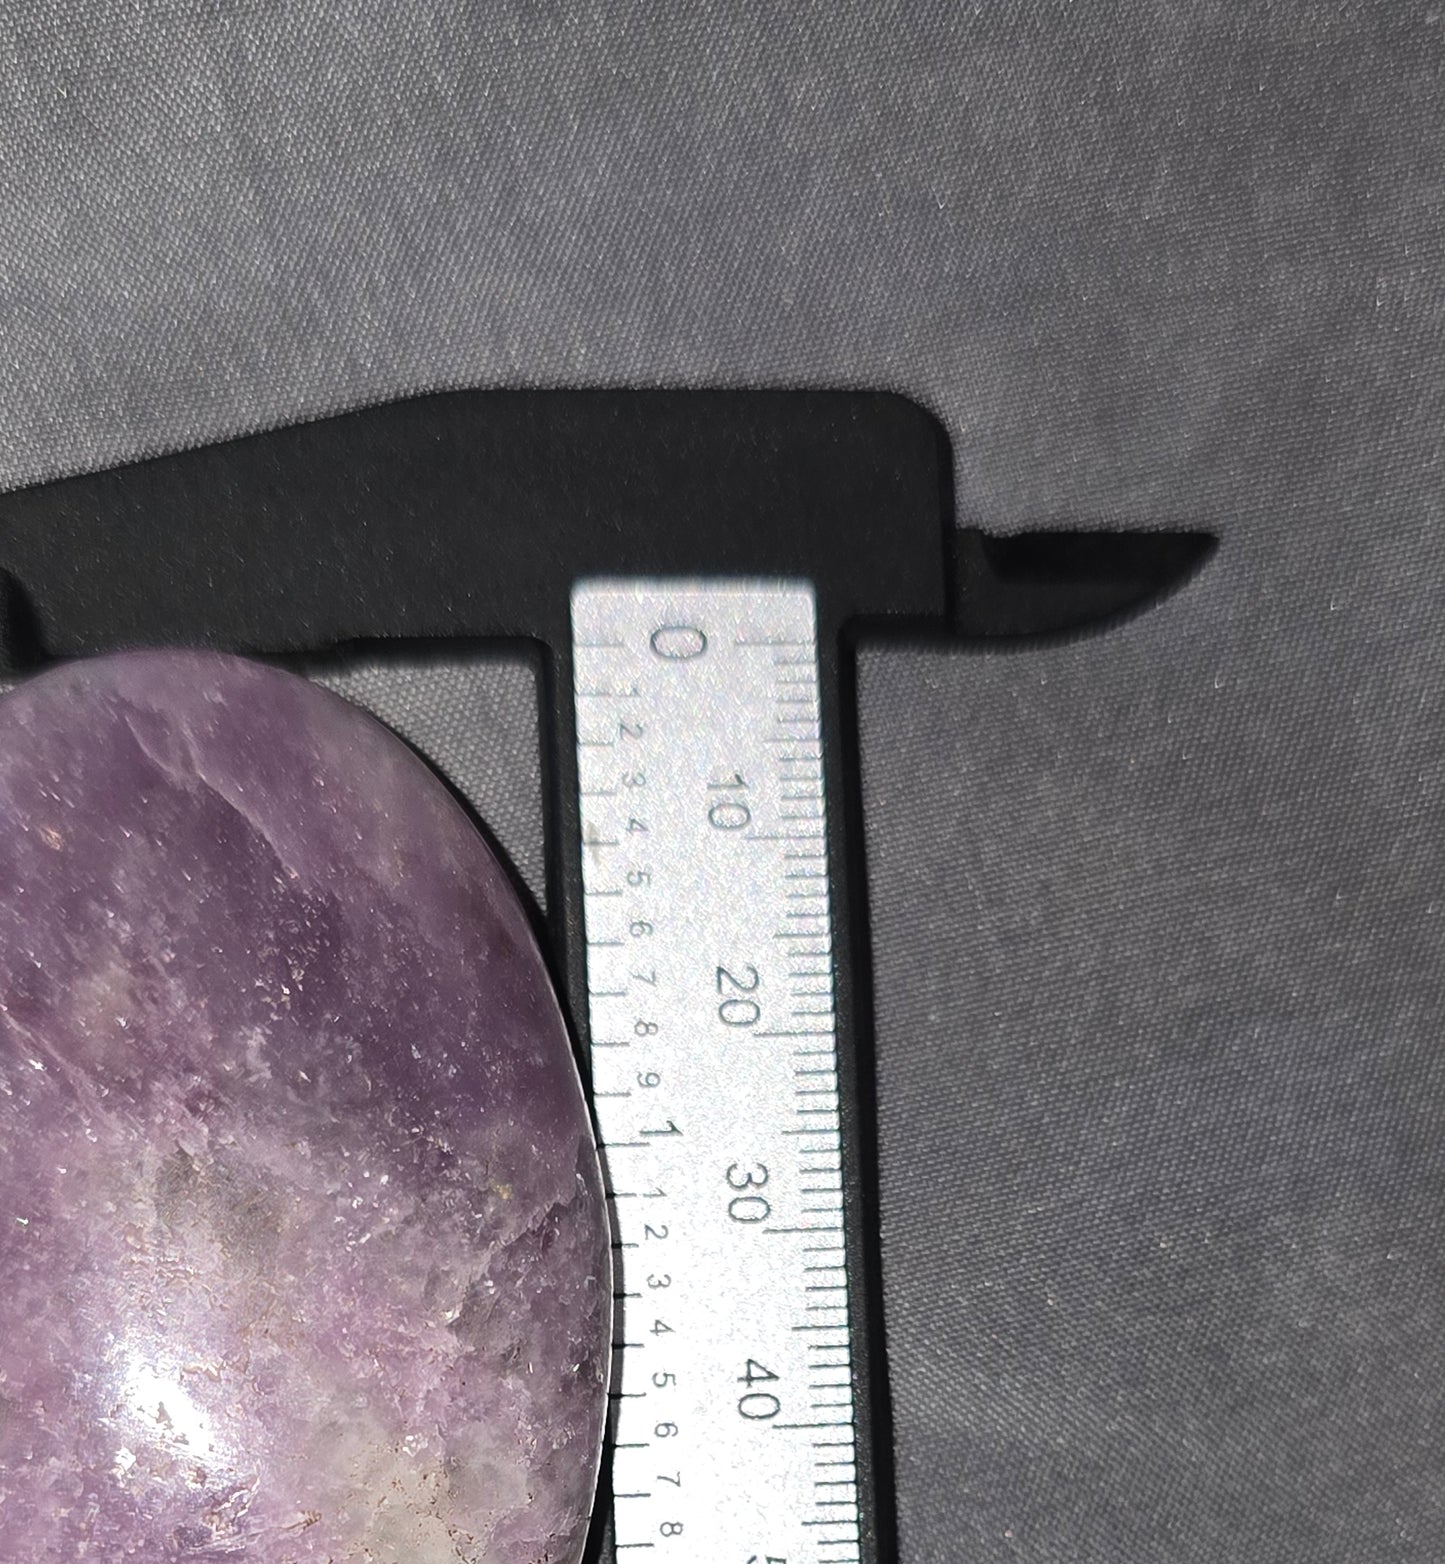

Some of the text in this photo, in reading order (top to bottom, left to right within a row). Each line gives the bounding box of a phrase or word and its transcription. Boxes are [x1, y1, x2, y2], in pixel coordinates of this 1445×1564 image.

[650, 626, 708, 660] 0
[619, 722, 645, 741] 2
[622, 772, 647, 789] 3
[707, 773, 751, 831] 10
[625, 818, 649, 835] 4
[626, 870, 651, 888] 5
[629, 920, 653, 938] 6
[632, 968, 657, 987] 7
[716, 965, 761, 1027] 20
[634, 1020, 658, 1037] 8
[637, 1071, 661, 1089] 9
[640, 1120, 684, 1137] 1
[726, 1161, 772, 1224] 30
[644, 1224, 669, 1241] 2
[647, 1273, 671, 1291] 3
[649, 1319, 675, 1336] 4
[652, 1371, 677, 1388] 5
[737, 1358, 780, 1420] 40
[654, 1421, 679, 1438] 6
[657, 1470, 681, 1487] 7
[660, 1521, 684, 1537] 8
